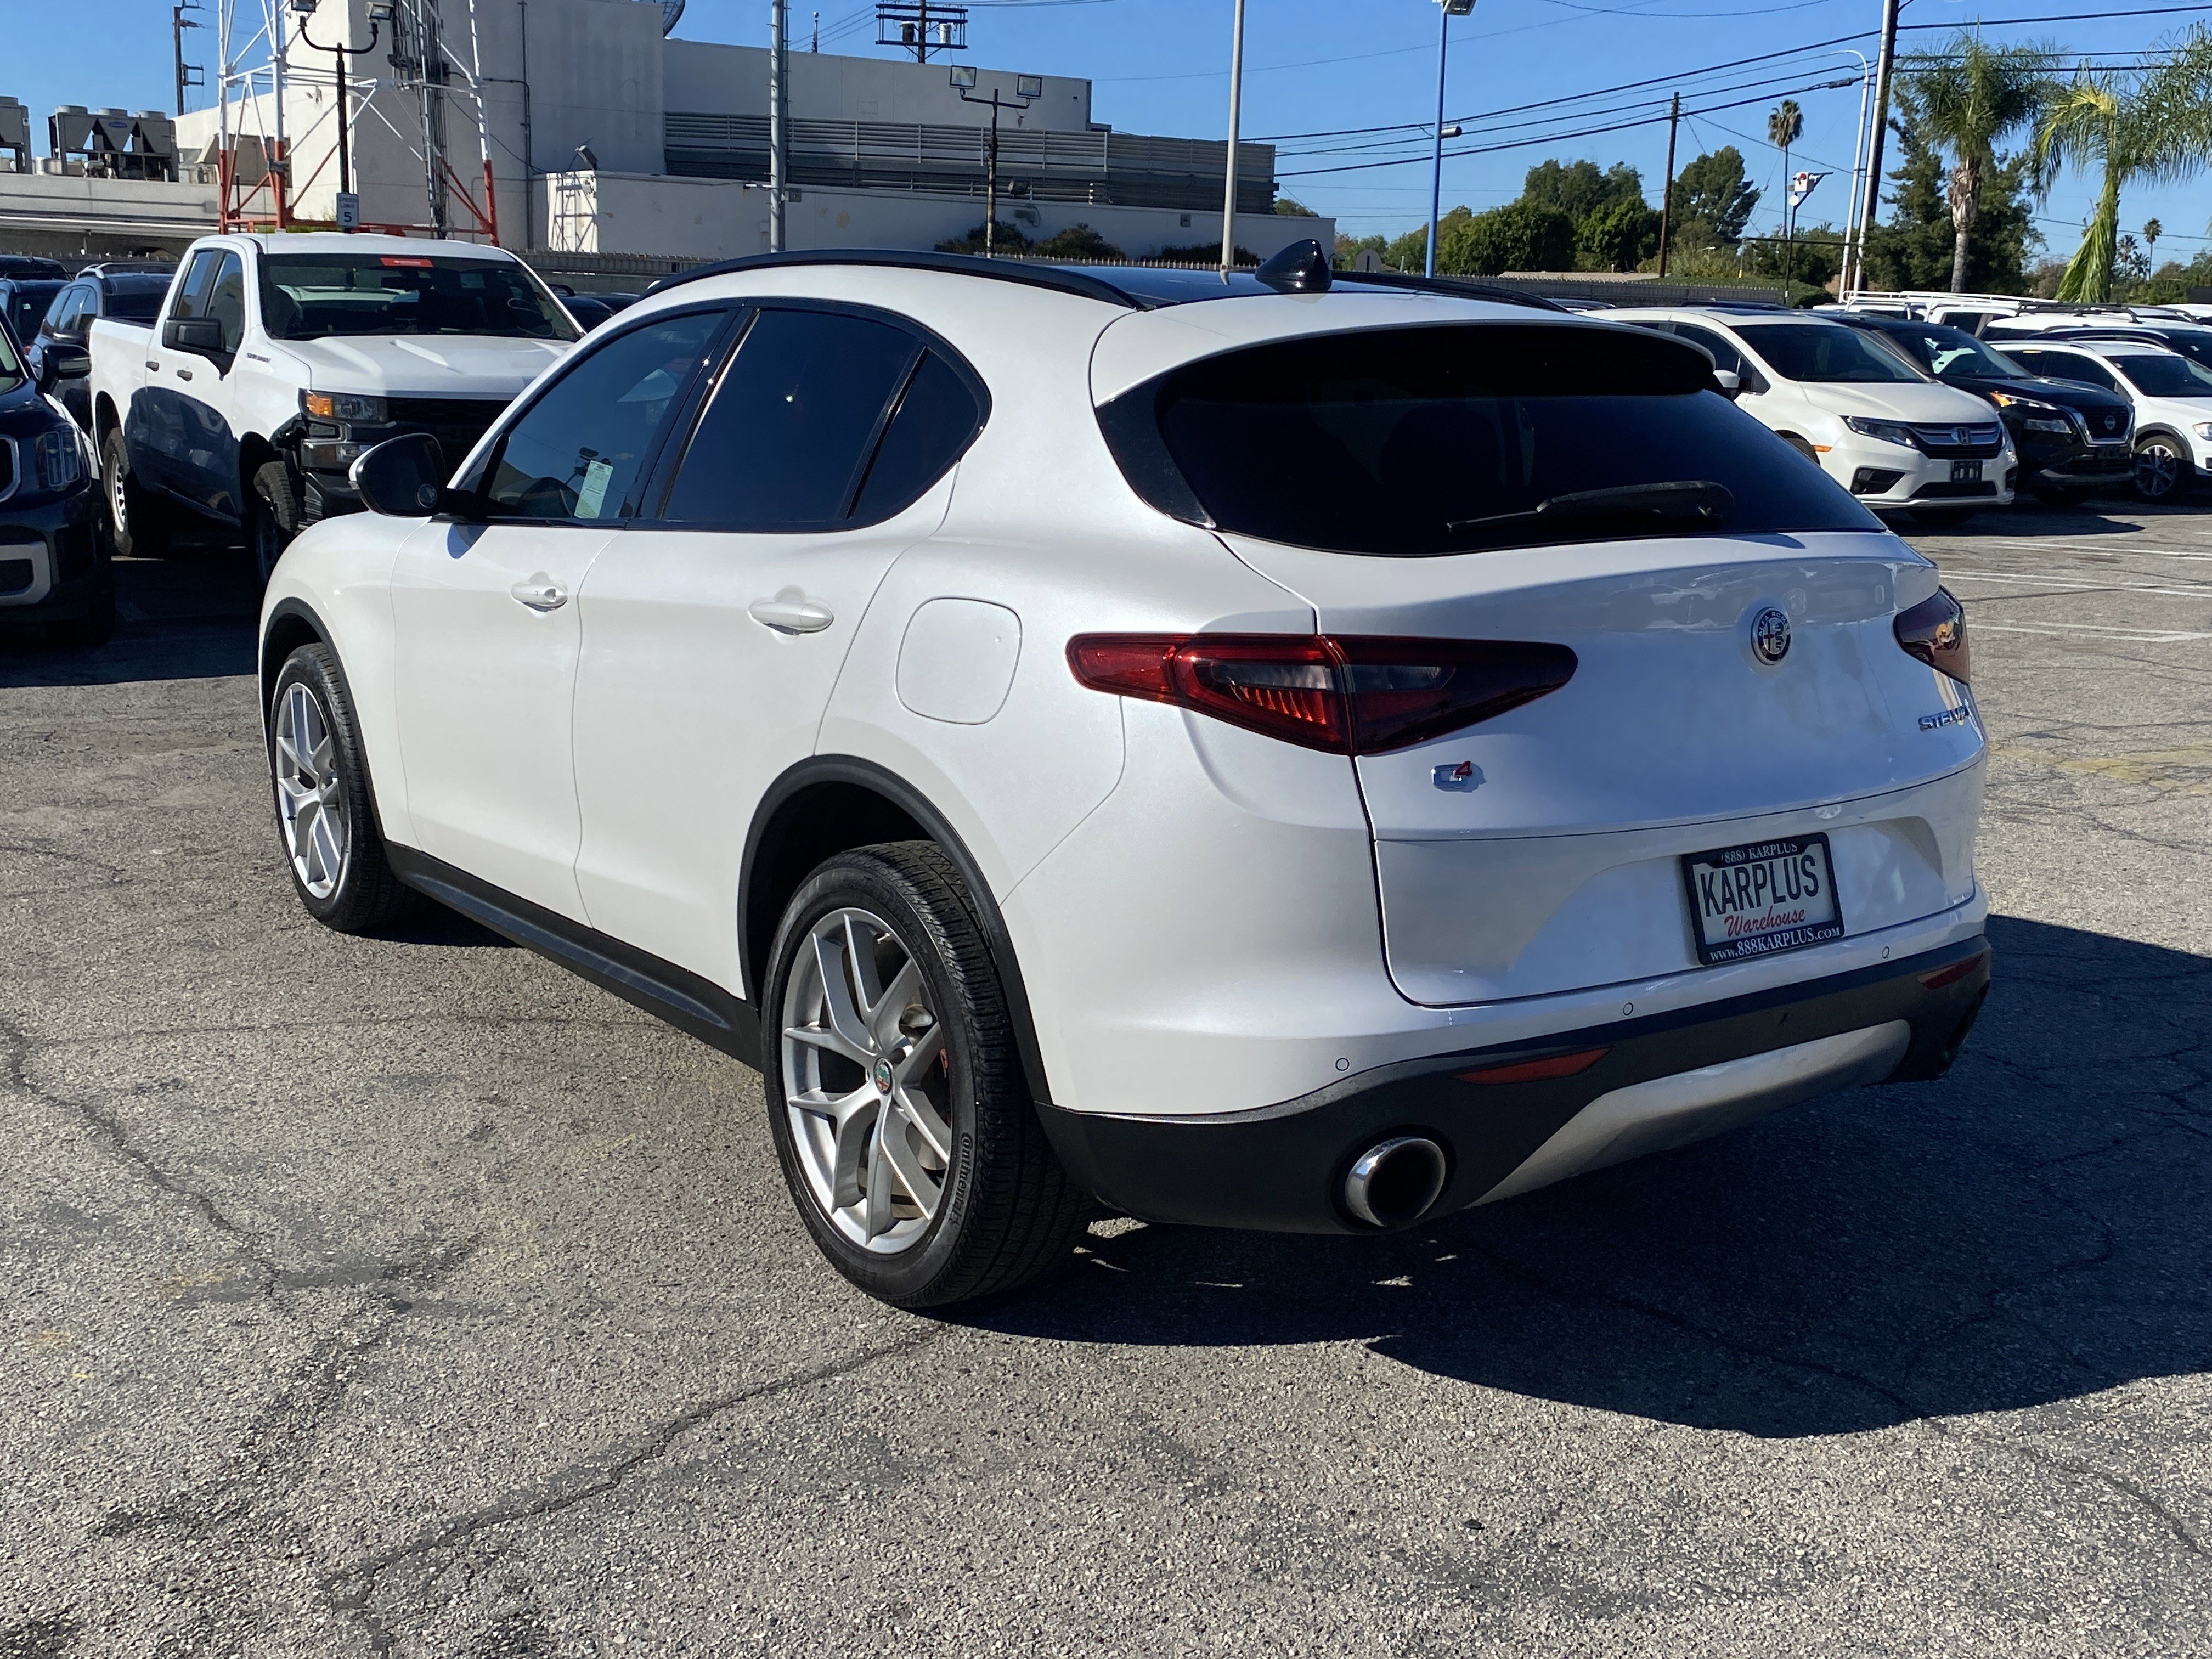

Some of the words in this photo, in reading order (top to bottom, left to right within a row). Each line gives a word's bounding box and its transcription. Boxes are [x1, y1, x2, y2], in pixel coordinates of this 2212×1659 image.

[344, 212, 352, 222] 5
[1721, 850, 1745, 864] (888)
[1748, 842, 1797, 859] KARPLUS
[1700, 854, 1819, 917] KARPLUS
[1724, 905, 1805, 938] Warehouse
[949, 1132, 973, 1225] Continental
